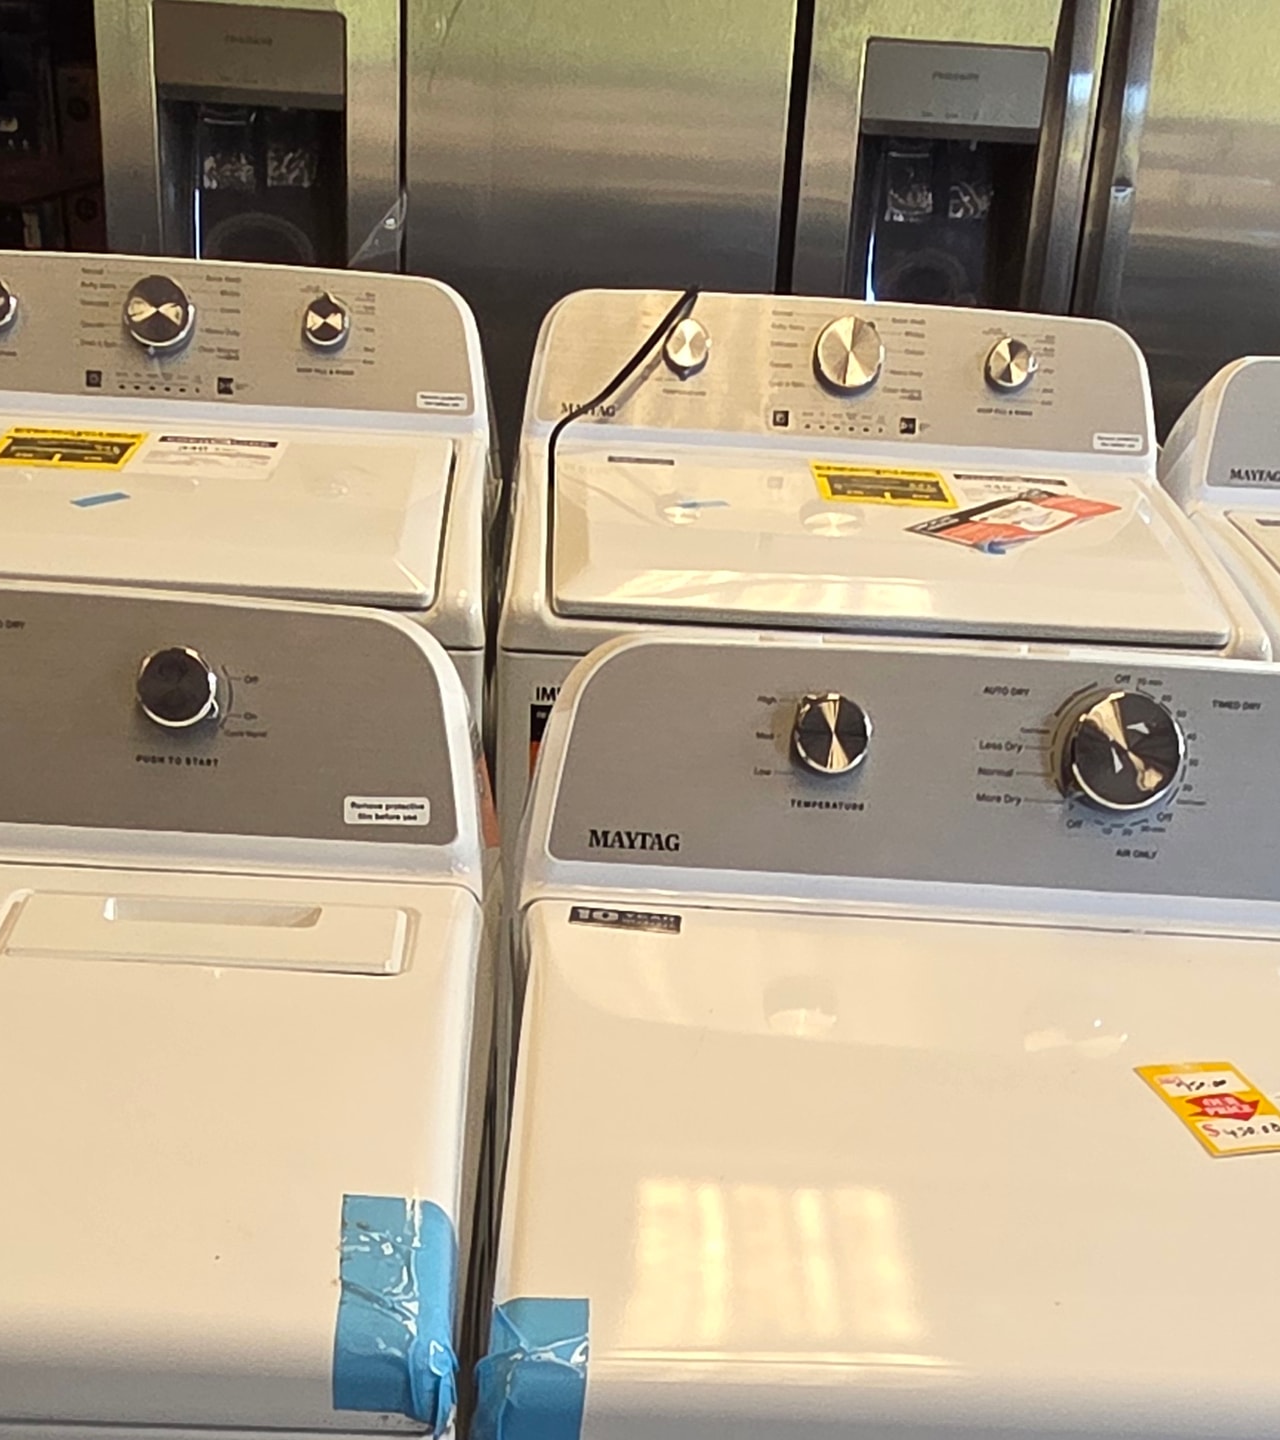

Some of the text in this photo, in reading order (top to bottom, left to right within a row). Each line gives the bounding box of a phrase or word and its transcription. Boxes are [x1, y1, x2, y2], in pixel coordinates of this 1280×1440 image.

[561, 402, 616, 418] MTAG
[790, 799, 865, 811] TEMPERATURE
[587, 828, 680, 852] MAYTAG
